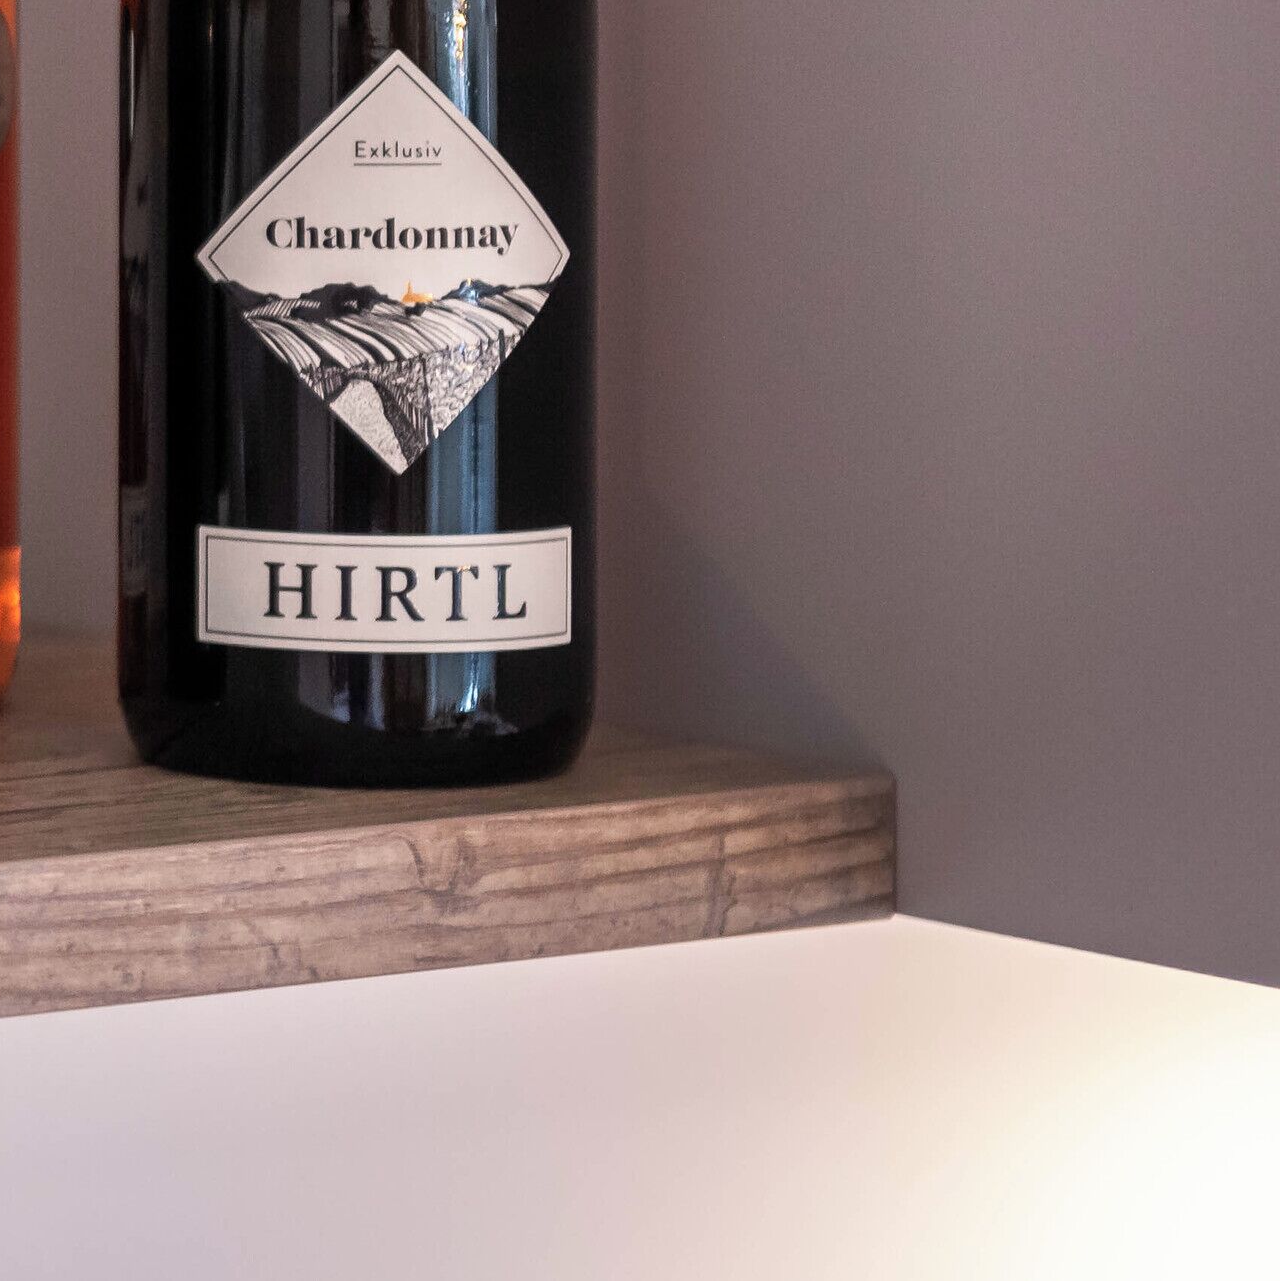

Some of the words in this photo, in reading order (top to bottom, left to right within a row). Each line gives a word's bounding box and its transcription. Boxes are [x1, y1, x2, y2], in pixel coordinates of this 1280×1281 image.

[353, 139, 443, 160] Exklusiv
[264, 216, 520, 256] Chardonnay
[262, 560, 528, 622] HIRTL
